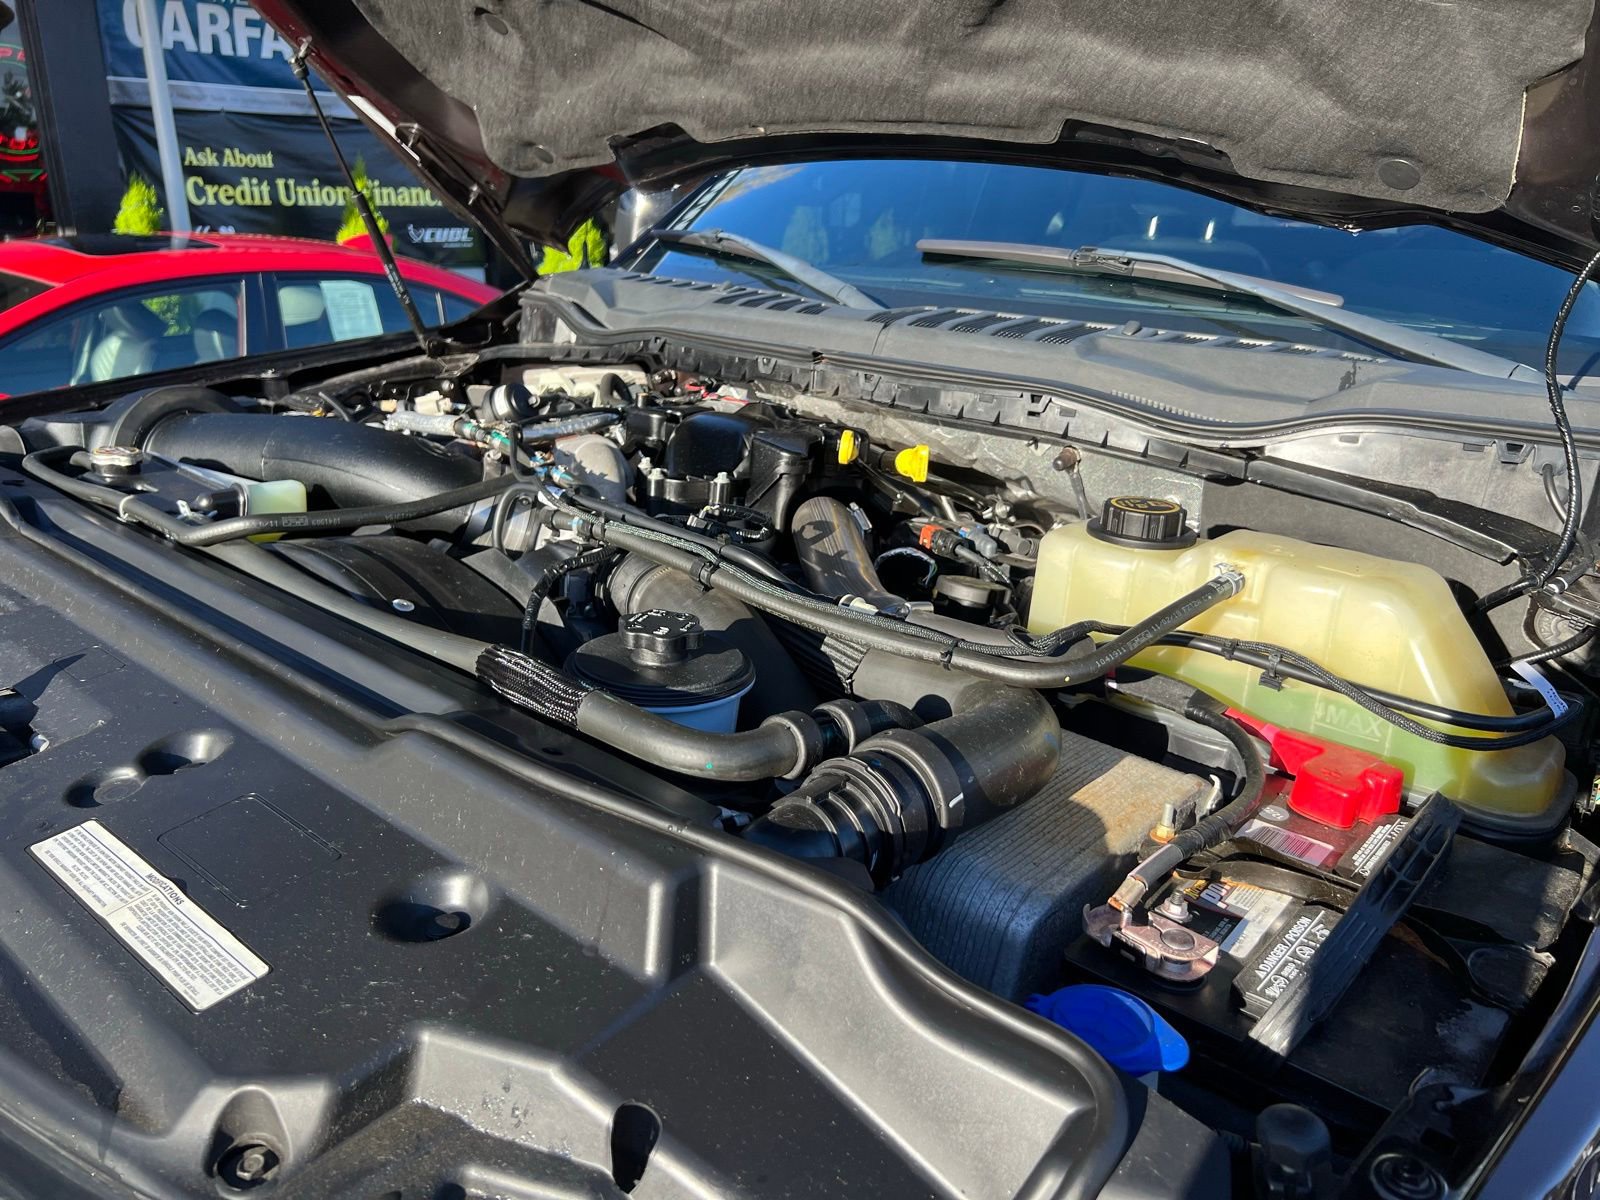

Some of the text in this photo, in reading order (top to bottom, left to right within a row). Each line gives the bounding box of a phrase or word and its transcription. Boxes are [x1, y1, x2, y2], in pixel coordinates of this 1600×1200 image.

[184, 146, 274, 169] Ask About
[186, 176, 273, 207] Credit
[275, 178, 353, 207] Union
[1326, 704, 1382, 738] MAX
[145, 872, 186, 906] MODIFICATIONS
[1258, 943, 1289, 973] DANGER
[1284, 915, 1313, 942] POISON
